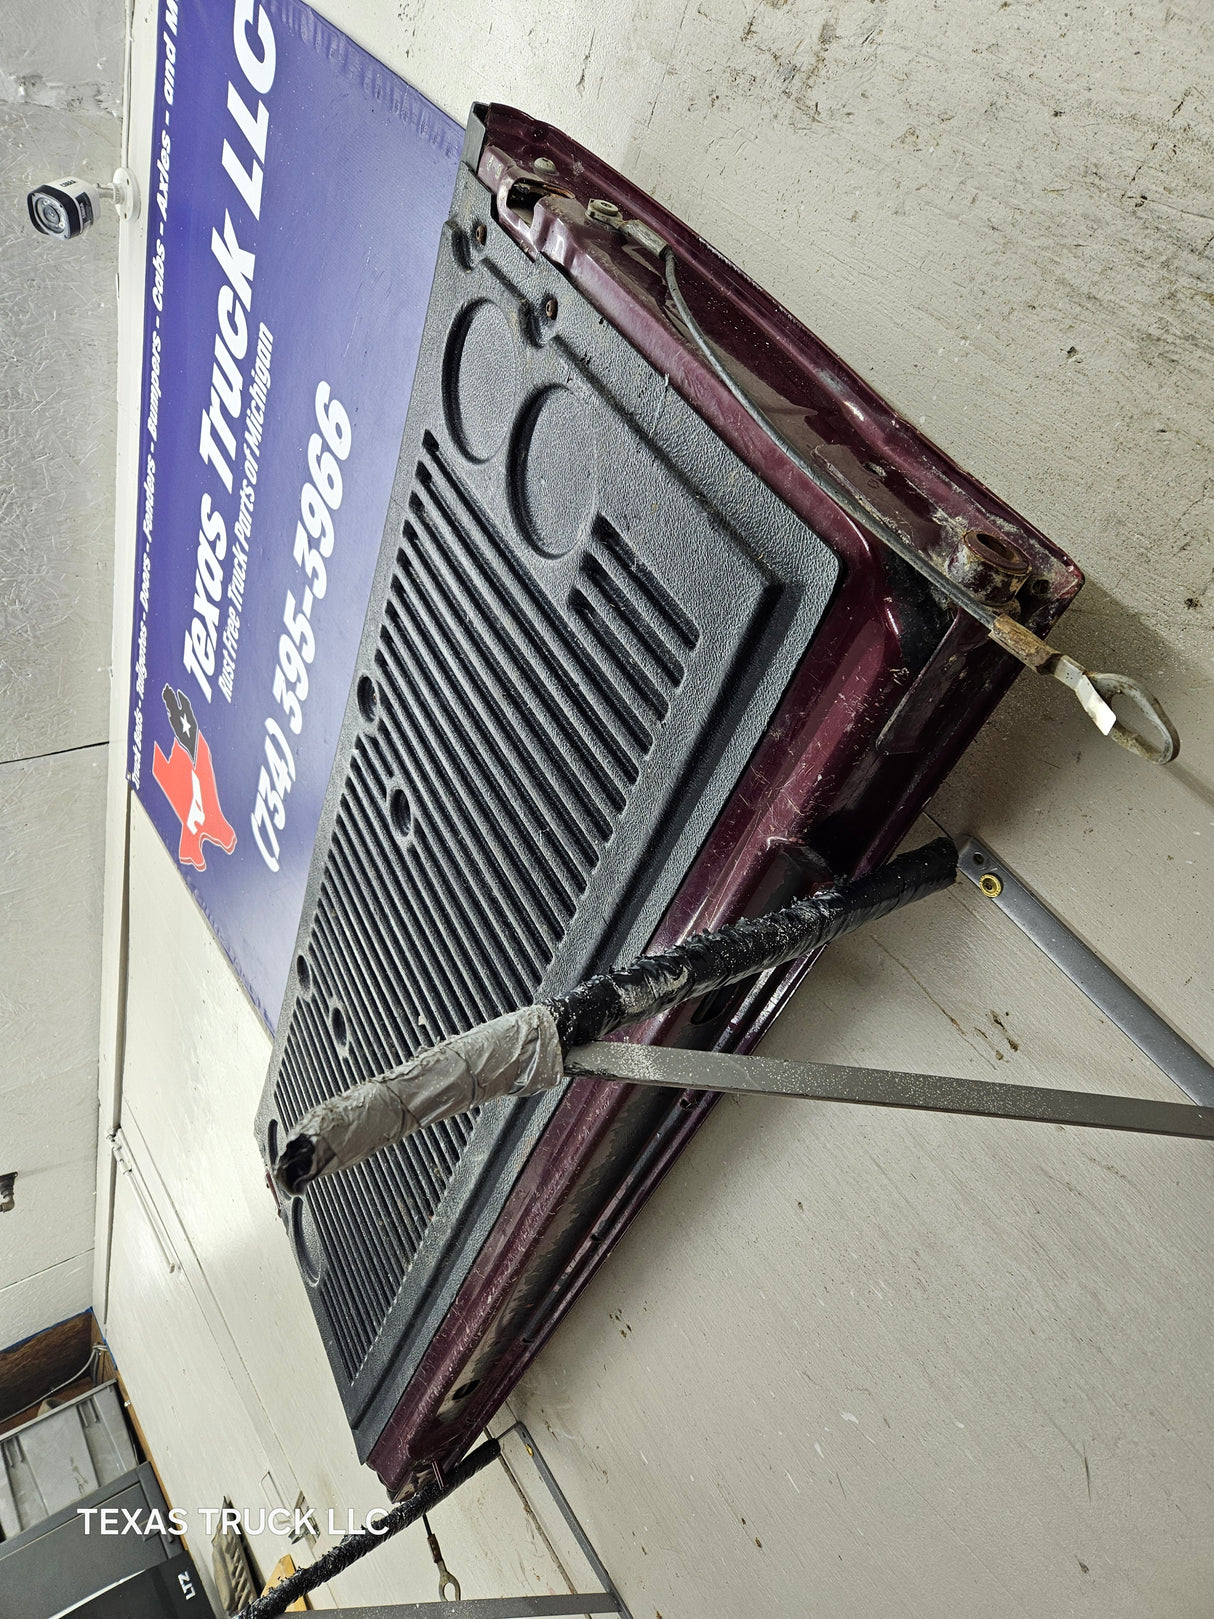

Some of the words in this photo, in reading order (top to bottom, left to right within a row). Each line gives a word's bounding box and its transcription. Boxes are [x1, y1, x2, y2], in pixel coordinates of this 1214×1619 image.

[163, 31, 176, 105] and
[221, 0, 277, 221] LLC
[157, 130, 171, 222] Axles
[152, 239, 165, 312] Cabs
[147, 331, 161, 441] Bumpers
[199, 208, 255, 494] Truck
[244, 322, 273, 457] Michigan
[143, 454, 156, 543] Fenders
[244, 442, 259, 485] of
[234, 479, 255, 552] Parts
[139, 552, 150, 613] Doors
[228, 542, 248, 613] Truck
[272, 381, 352, 735] 395-3966
[183, 493, 227, 703] Texas
[223, 606, 240, 660] Free
[135, 620, 147, 700] Tailgates
[218, 647, 236, 703] Rust
[134, 707, 143, 751] Beds
[131, 745, 142, 790] Truck
[251, 717, 296, 873] (734)
[178, 1571, 196, 1600] LTZ
